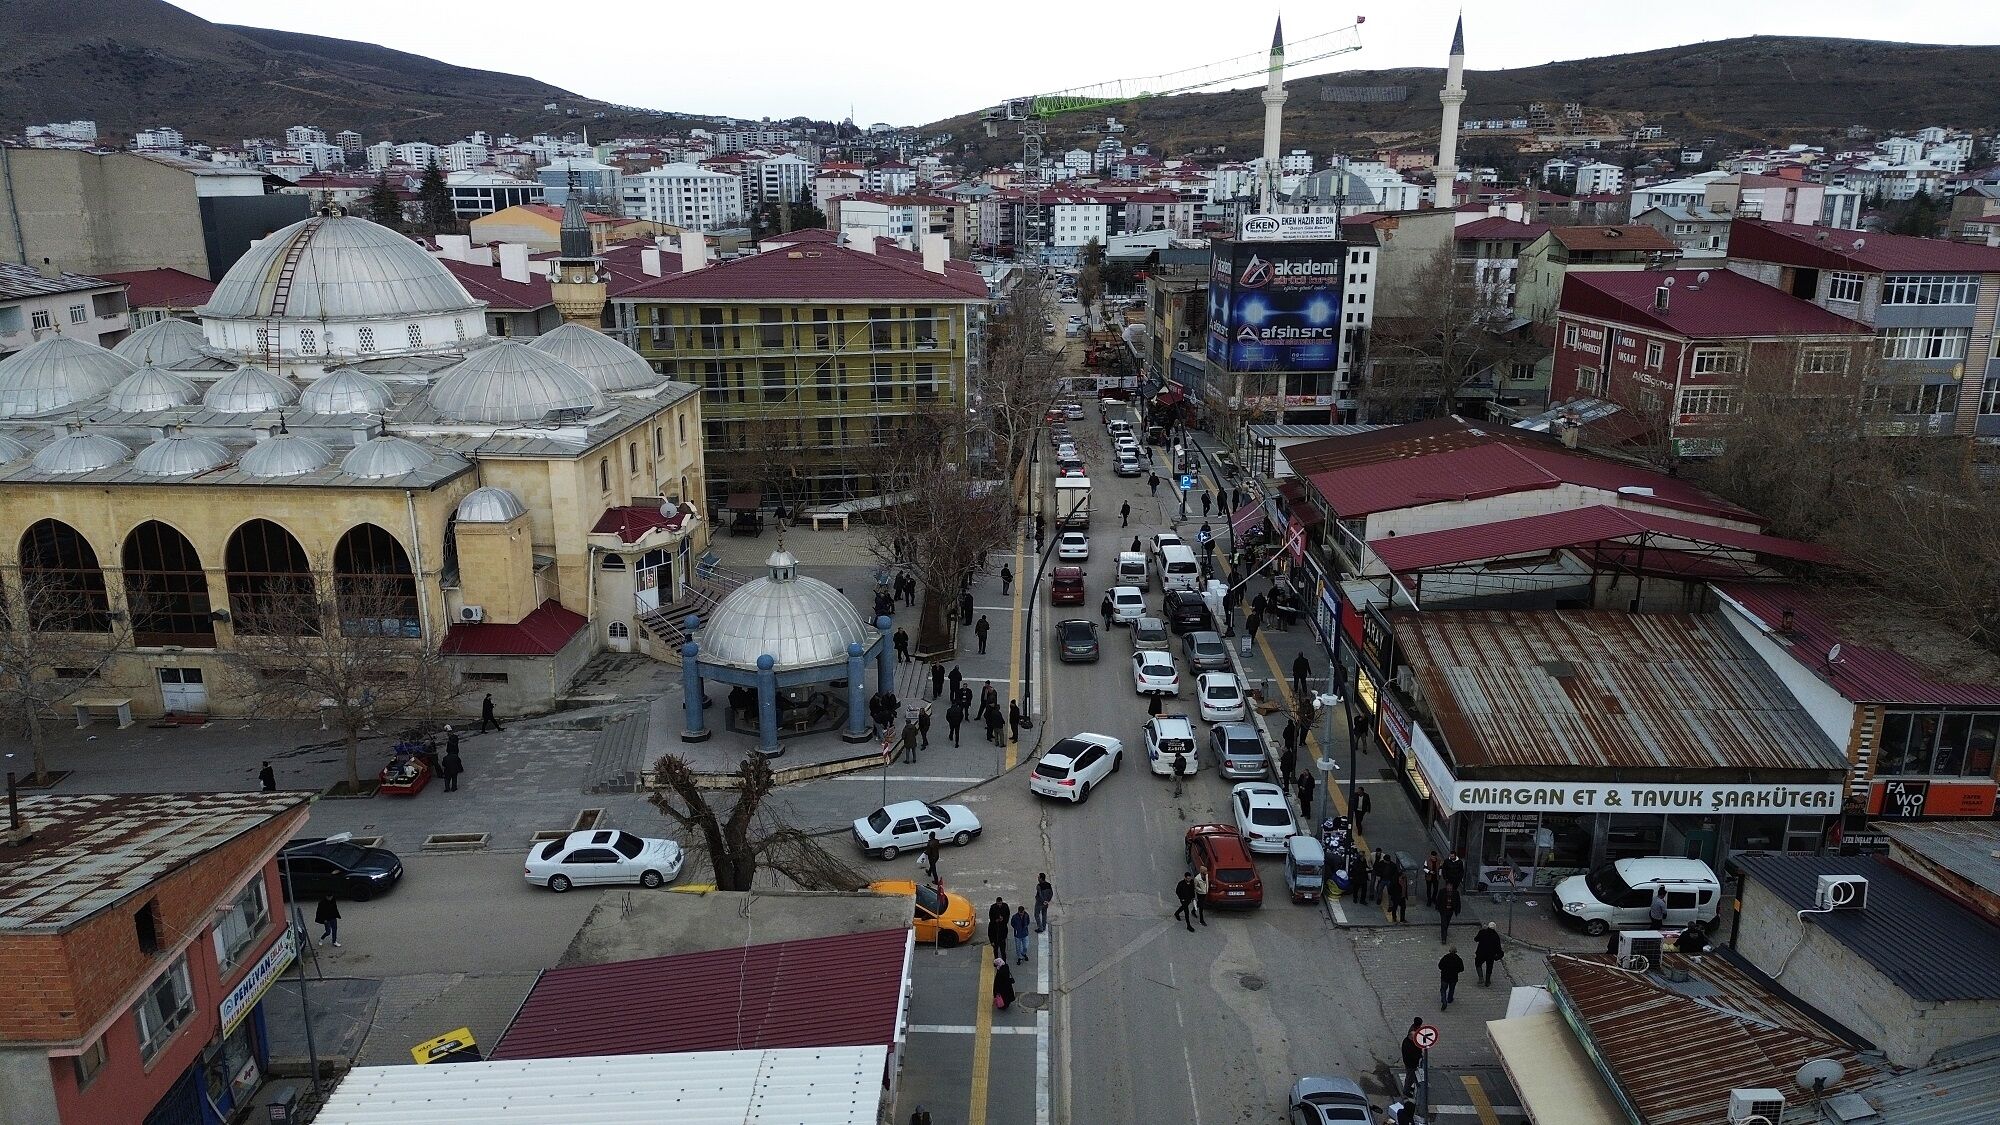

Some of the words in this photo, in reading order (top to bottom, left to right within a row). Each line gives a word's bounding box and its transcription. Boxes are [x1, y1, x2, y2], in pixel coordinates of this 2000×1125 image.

[1250, 221, 1274, 229] EKEN
[1282, 217, 1296, 225] EKEN
[1298, 216, 1315, 225] HAZIR
[1316, 216, 1334, 225] BETON
[1275, 259, 1338, 275] akademi
[1622, 336, 1636, 348] MEKA
[1618, 349, 1637, 364] İNŞAAT
[1363, 614, 1384, 650] SARAY
[1886, 783, 1906, 794] FA
[1573, 790, 1597, 806] ET
[1604, 790, 1622, 806] &
[1631, 790, 1703, 806] TAVUK
[1896, 794, 1924, 806] WO
[1901, 806, 1918, 817] RI
